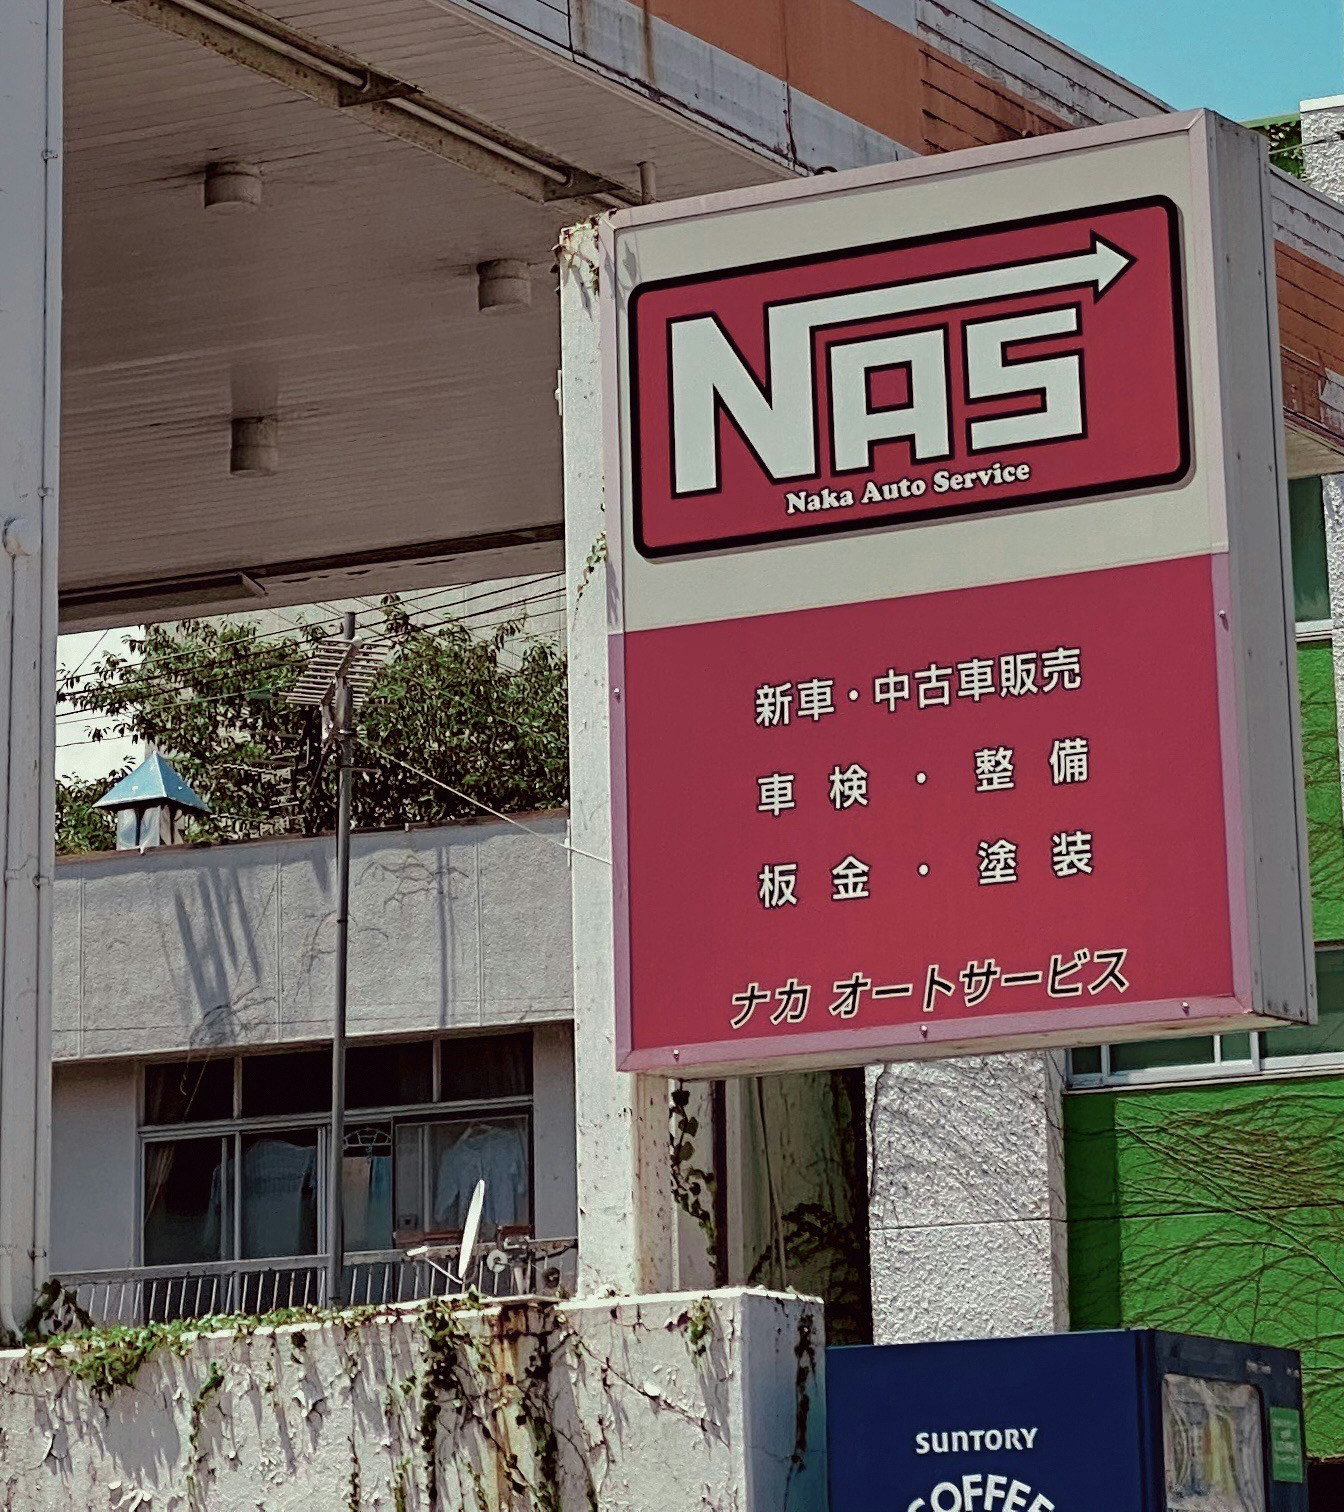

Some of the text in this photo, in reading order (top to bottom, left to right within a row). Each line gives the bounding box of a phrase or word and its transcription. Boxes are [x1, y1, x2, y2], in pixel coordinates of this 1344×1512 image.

[668, 304, 1086, 496] NAS
[785, 461, 1031, 515] Naka Auto Service
[755, 646, 1083, 728] 新車・中古車販売
[730, 947, 1129, 1029] ナカ オートサービス
